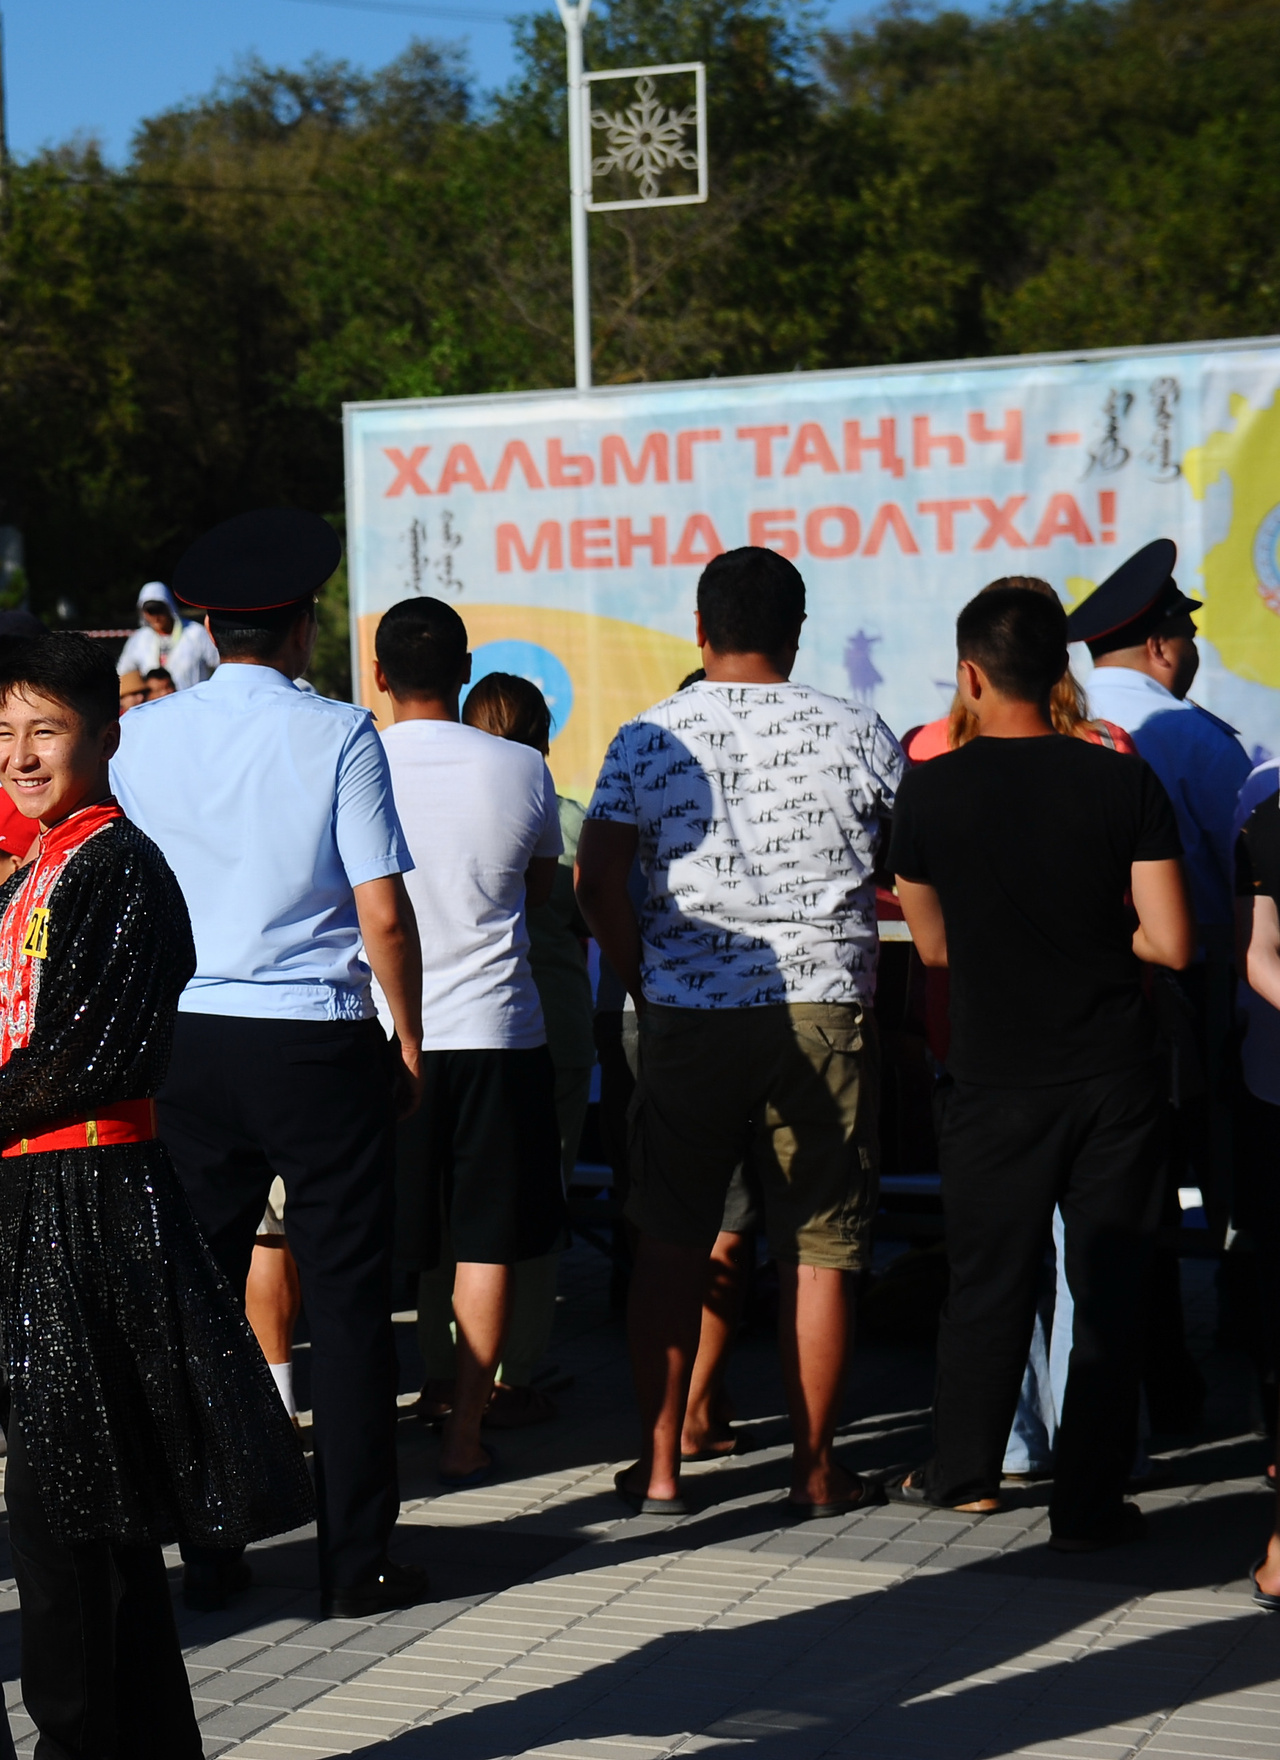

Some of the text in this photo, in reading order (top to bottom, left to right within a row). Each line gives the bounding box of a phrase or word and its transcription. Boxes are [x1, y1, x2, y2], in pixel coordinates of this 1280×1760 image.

[383, 427, 723, 498] ХАЛЬМГ
[736, 407, 1026, 479] ТАҢҺЧ
[494, 512, 727, 574] МЕНД
[748, 490, 1117, 560] БОЛТХА!
